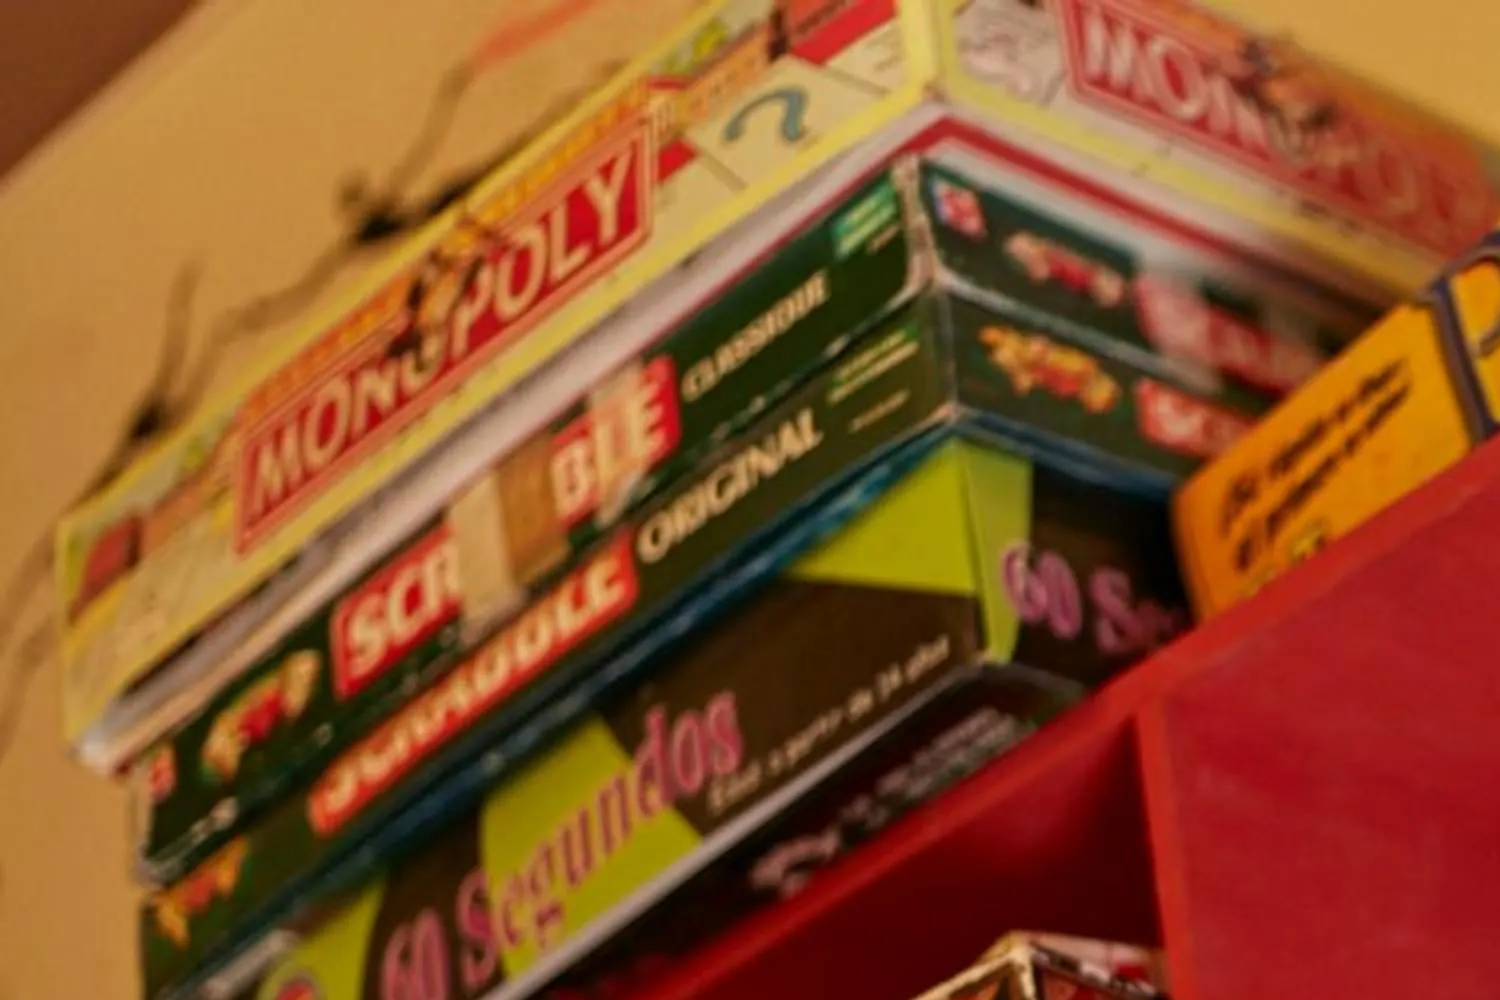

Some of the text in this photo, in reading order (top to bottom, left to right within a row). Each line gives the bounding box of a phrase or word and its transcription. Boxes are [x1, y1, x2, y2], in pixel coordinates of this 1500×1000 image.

[636, 407, 823, 564] ORIGINAL
[998, 539, 1082, 641] 60
[455, 690, 744, 989] Segundos
